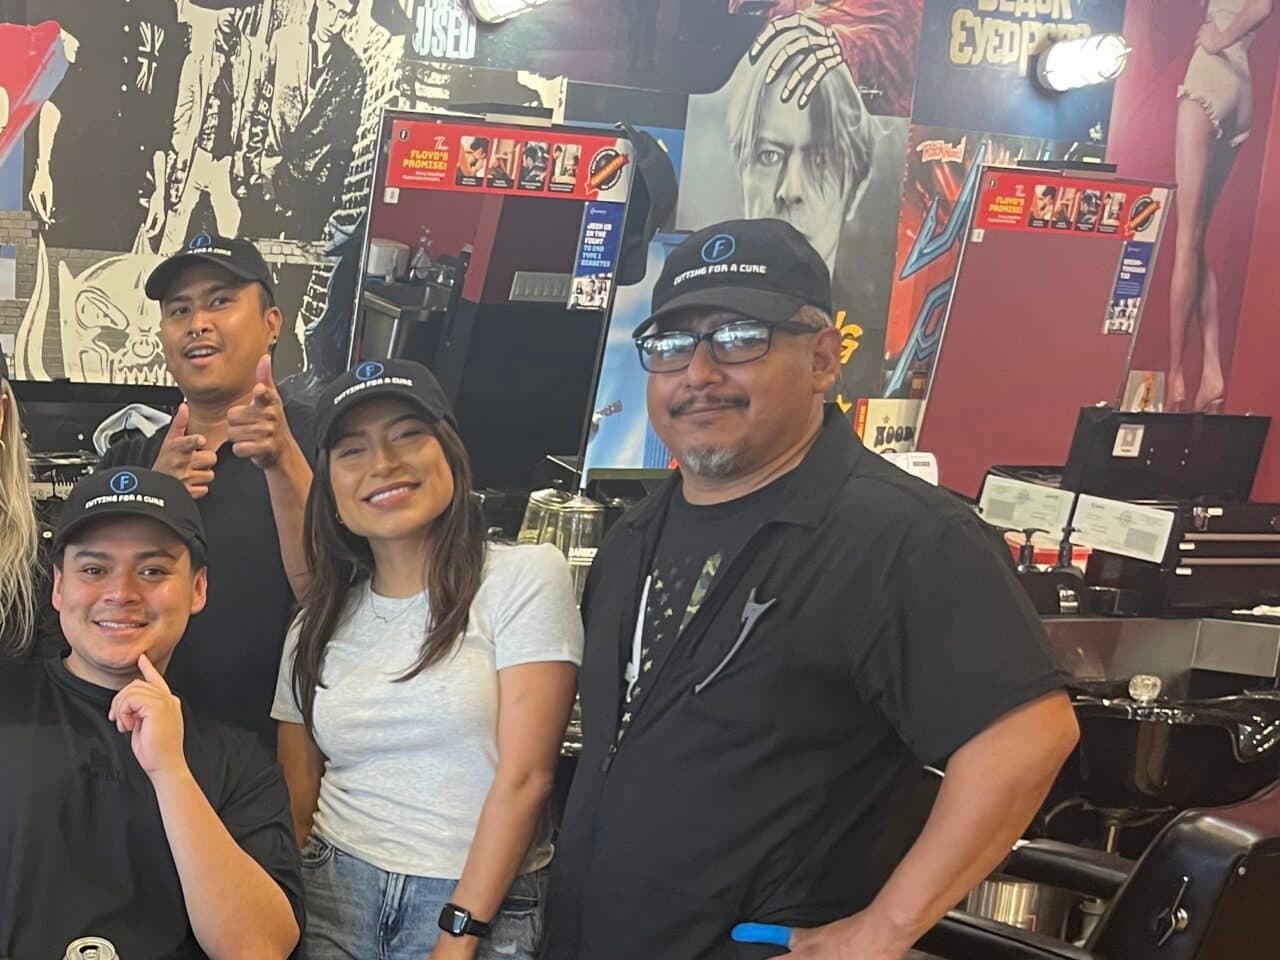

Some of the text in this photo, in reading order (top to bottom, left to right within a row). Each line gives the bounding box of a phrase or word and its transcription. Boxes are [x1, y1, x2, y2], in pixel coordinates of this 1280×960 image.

[949, 8, 1020, 66] EYED
[410, 149, 449, 160] FLOYD'S
[673, 265, 708, 286] CUTTING
[708, 264, 729, 274] FOR
[739, 263, 767, 274] CURE
[333, 382, 366, 405] CUTTING
[85, 494, 118, 509] CUTTING
[118, 494, 136, 502] FOR
[143, 495, 165, 508] CURE
